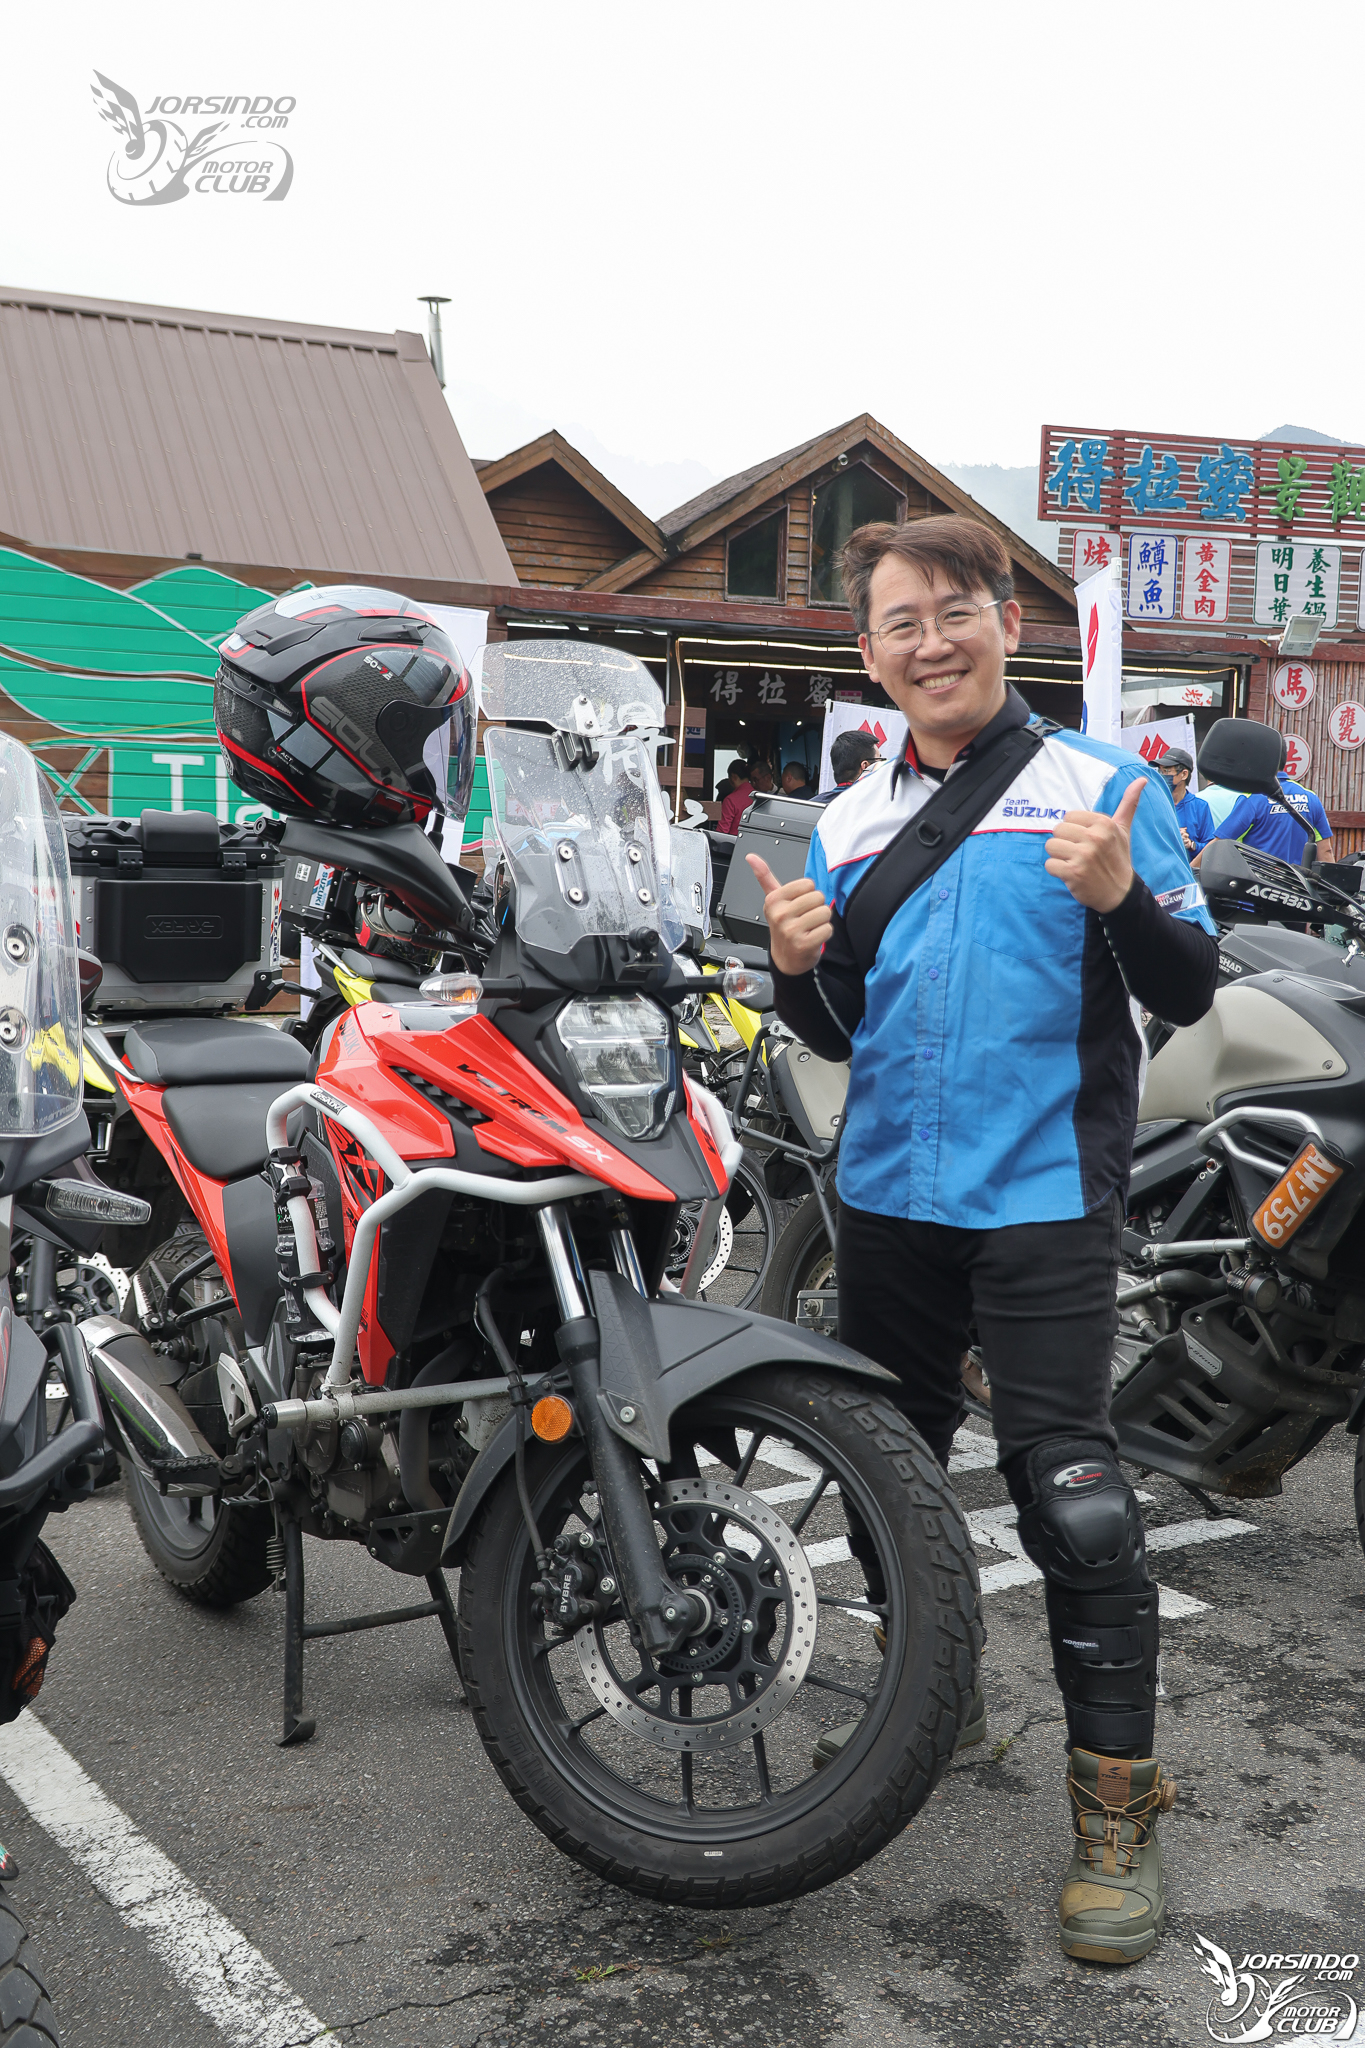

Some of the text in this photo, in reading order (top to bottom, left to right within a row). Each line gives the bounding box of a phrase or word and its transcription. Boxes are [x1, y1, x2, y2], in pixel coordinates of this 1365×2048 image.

[1137, 538, 1169, 615] 鱒魚
[1193, 541, 1220, 618] 黃金肉
[1268, 546, 1294, 622] 明日葉
[1280, 666, 1307, 705] 馬
[1002, 806, 1066, 820] SUZUKI
[1004, 798, 1029, 806] Team
[314, 871, 329, 906] SUZUKI
[1218, 955, 1242, 974] SHAD
[559, 1574, 572, 1613] BYBRE
